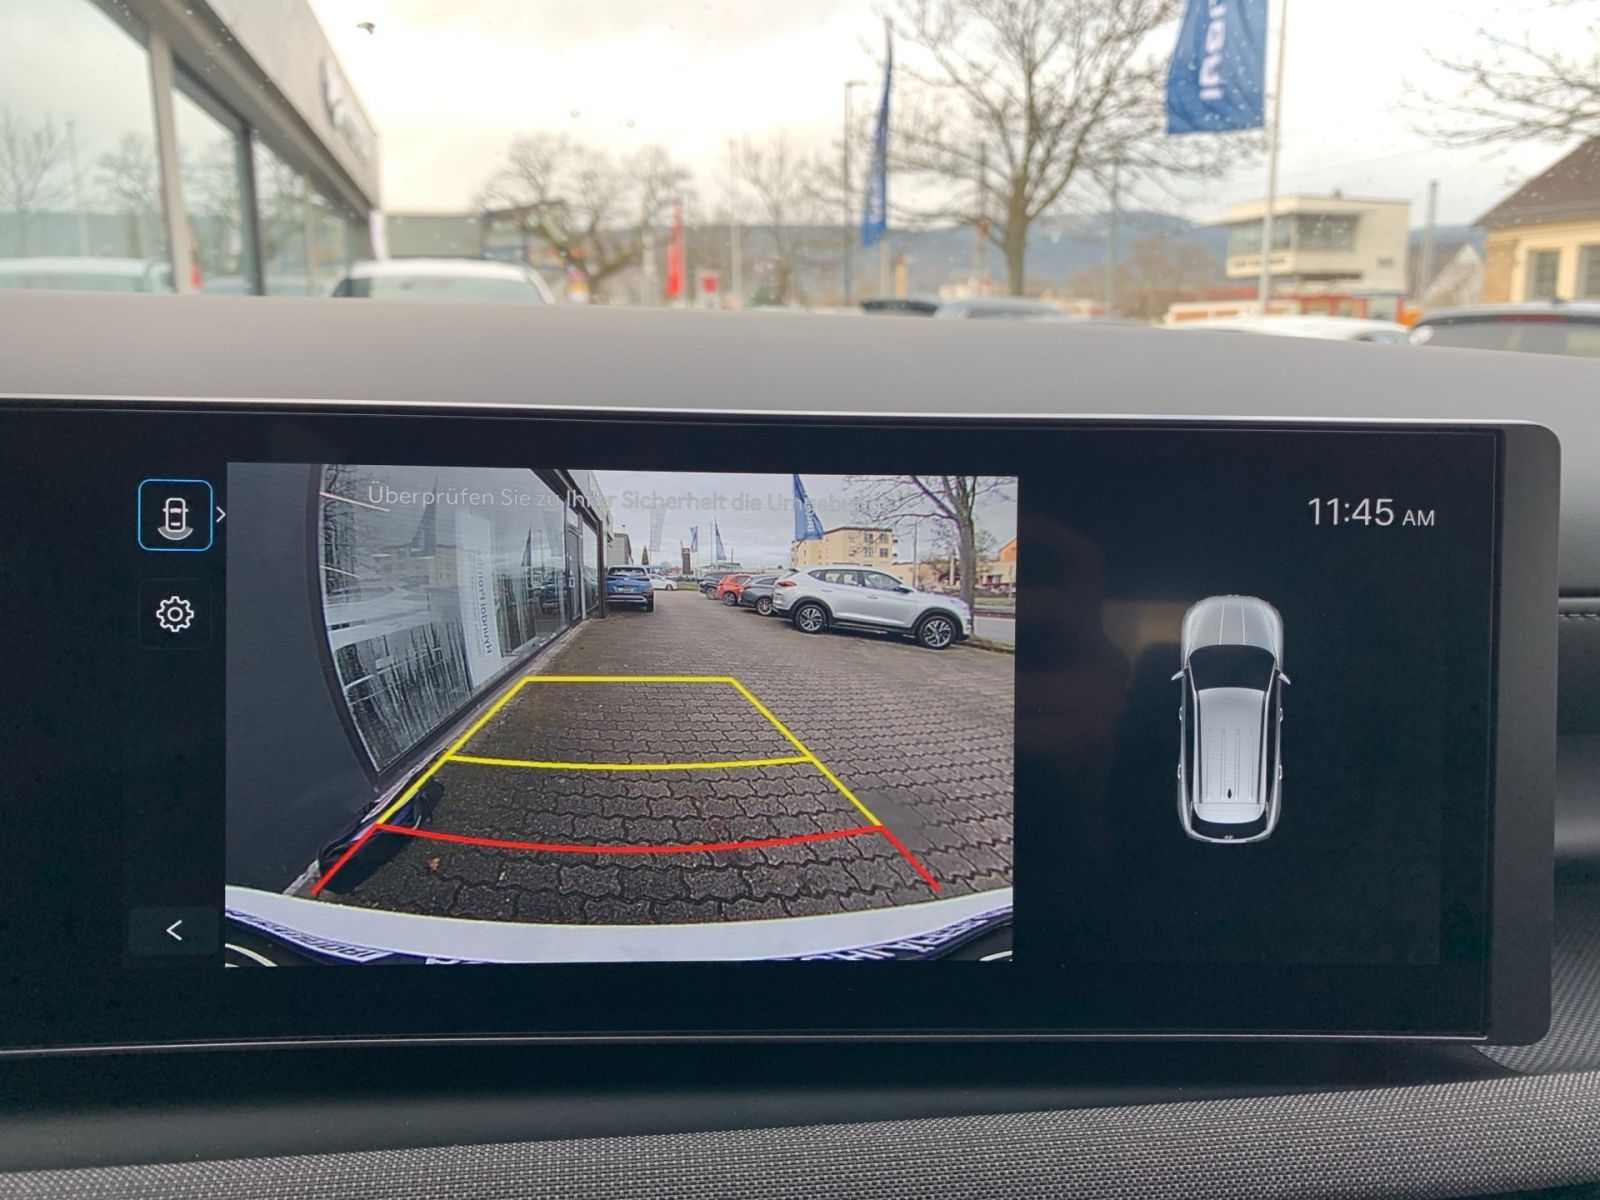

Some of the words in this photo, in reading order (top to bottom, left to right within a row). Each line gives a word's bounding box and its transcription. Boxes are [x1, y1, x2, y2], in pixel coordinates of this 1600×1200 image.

[367, 480, 494, 508] Überprüfen
[501, 488, 531, 507] Sie
[536, 492, 560, 508] zu
[622, 490, 726, 511] Sicherheit
[732, 493, 761, 512] die
[1308, 497, 1395, 526] 11:45
[1402, 509, 1435, 526] AM
